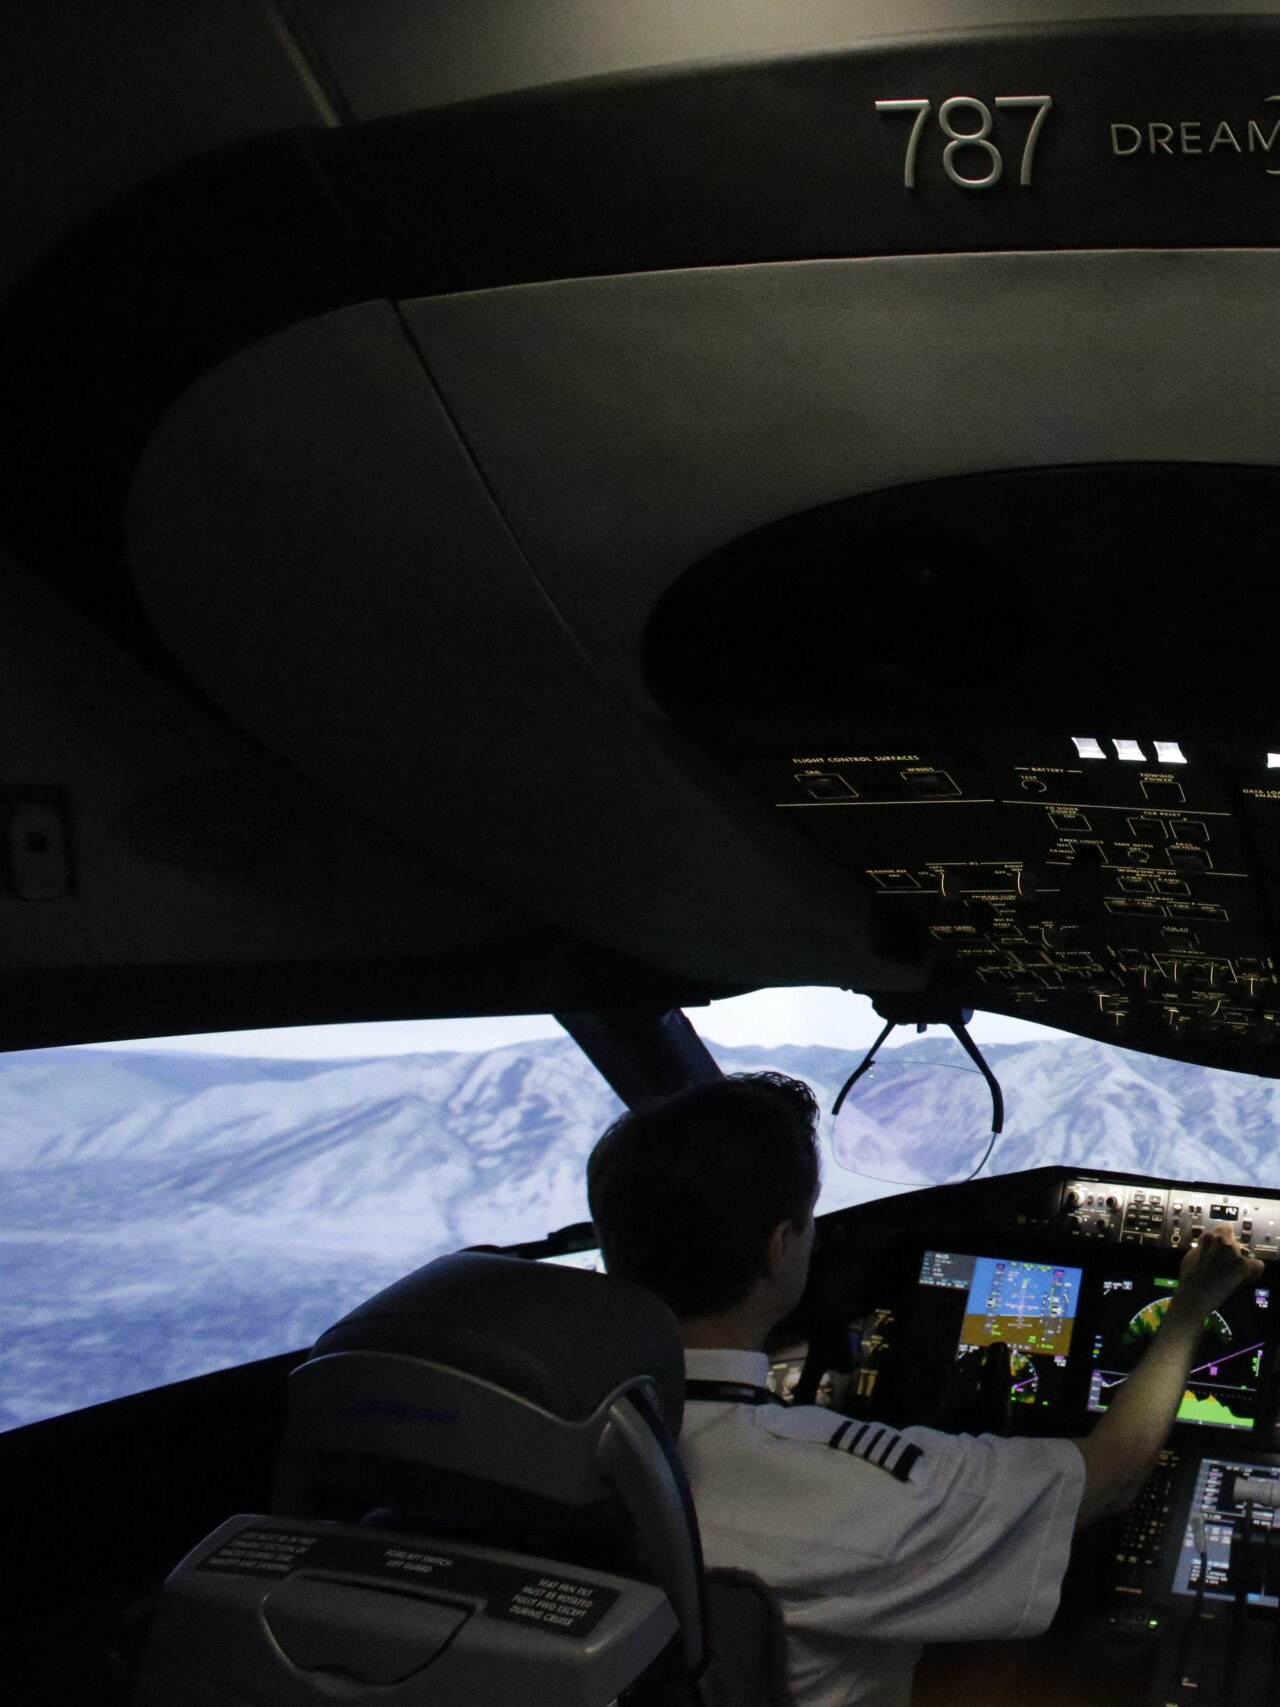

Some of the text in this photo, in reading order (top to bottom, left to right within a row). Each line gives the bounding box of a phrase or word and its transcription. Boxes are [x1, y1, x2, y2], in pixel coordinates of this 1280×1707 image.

[875, 95, 1052, 188] 787
[873, 754, 920, 762] SURFACES
[1031, 766, 1065, 774] BATTERY
[424, 1555, 453, 1566] SWITCH
[523, 1586, 593, 1608] MUST BE ROTATED
[538, 1578, 593, 1597] SEAT PAN TILT
[509, 1605, 575, 1626] DURING CRUISE
[512, 1594, 587, 1618] FULLY FWD EXCEPT
